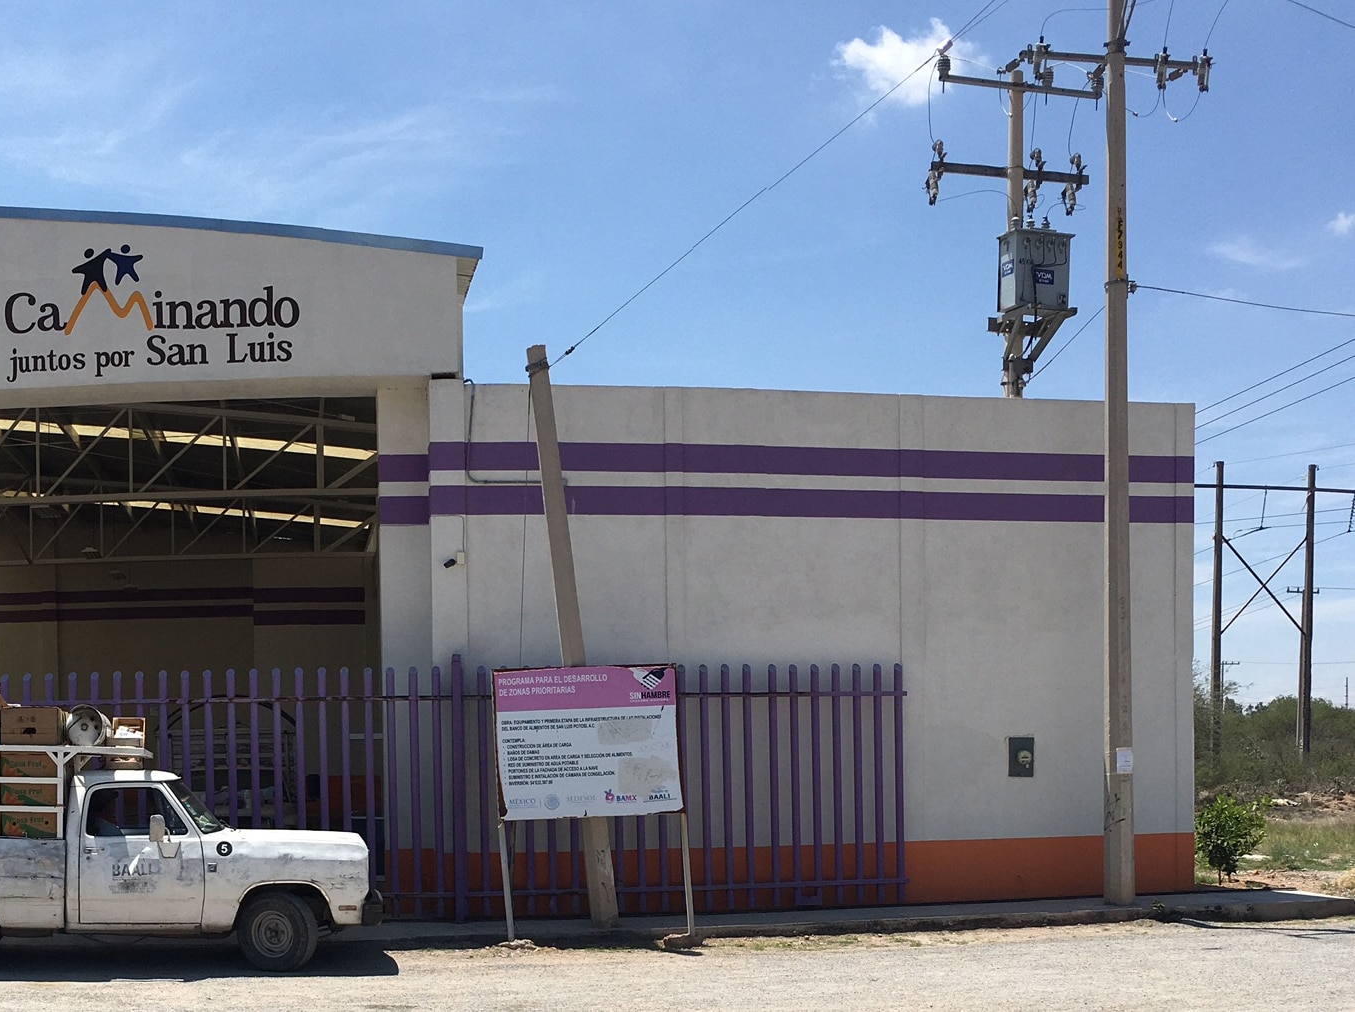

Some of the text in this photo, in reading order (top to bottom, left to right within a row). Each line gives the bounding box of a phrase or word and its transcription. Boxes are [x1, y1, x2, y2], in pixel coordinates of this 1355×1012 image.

[6, 332, 293, 382] juntos por San Luis
[498, 677, 534, 686] PROGRAMA
[536, 676, 553, 684] PARA
[564, 674, 608, 683] DESARROLLO
[499, 686, 576, 697] DE ZONAS PRIORITARIAS
[221, 844, 228, 853] 5
